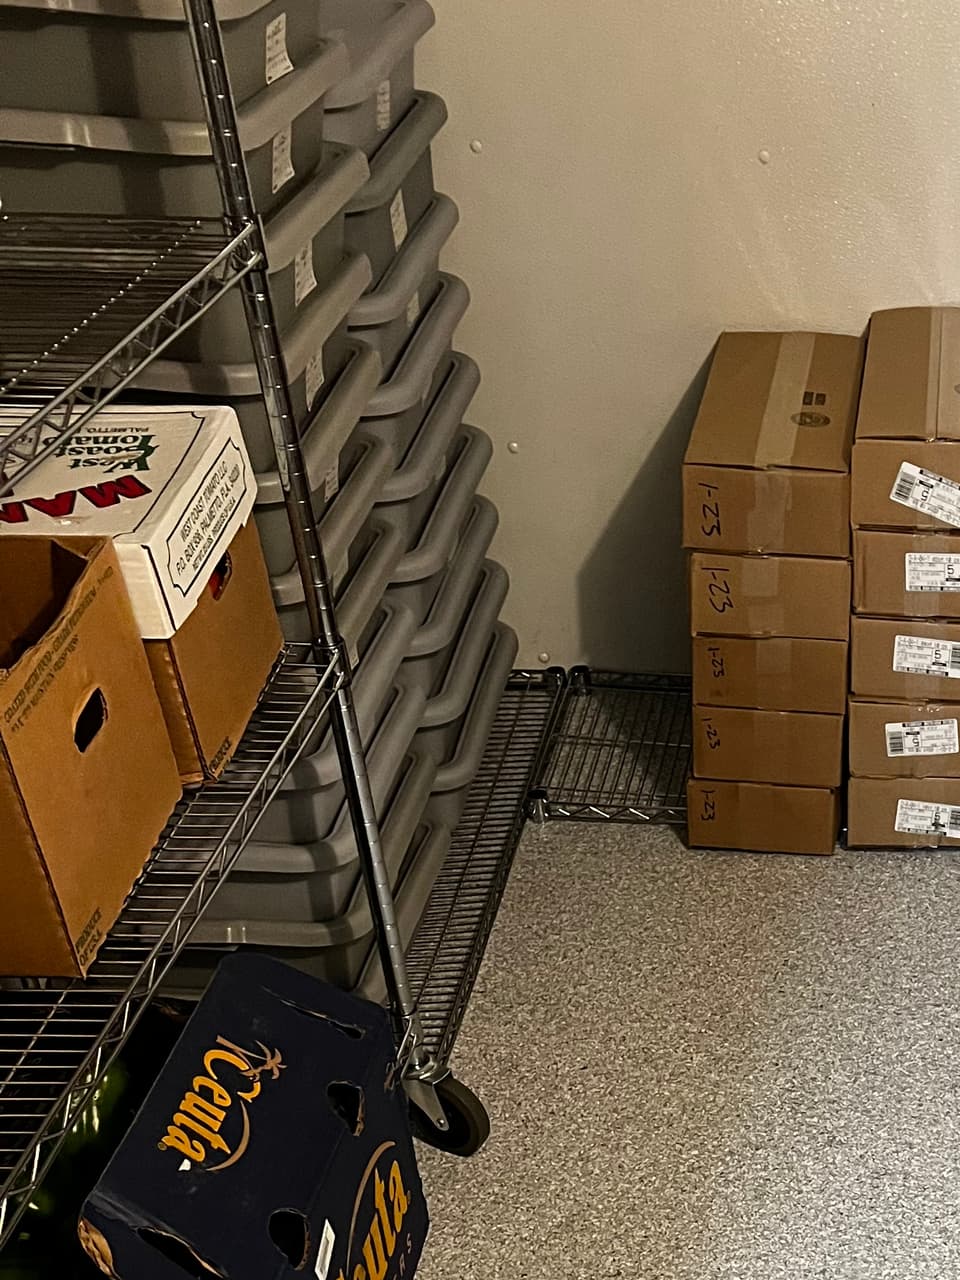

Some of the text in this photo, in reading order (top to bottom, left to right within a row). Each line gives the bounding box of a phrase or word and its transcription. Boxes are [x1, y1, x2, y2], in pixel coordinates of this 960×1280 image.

[54, 445, 159, 458] Coast
[68, 457, 151, 473] West
[698, 482, 721, 536] 1-23
[701, 567, 734, 613] 1-23
[707, 647, 725, 678] 1-23
[701, 718, 720, 749] 1-23
[701, 789, 716, 821] 1-23
[160, 1047, 262, 1164] Ceuta
